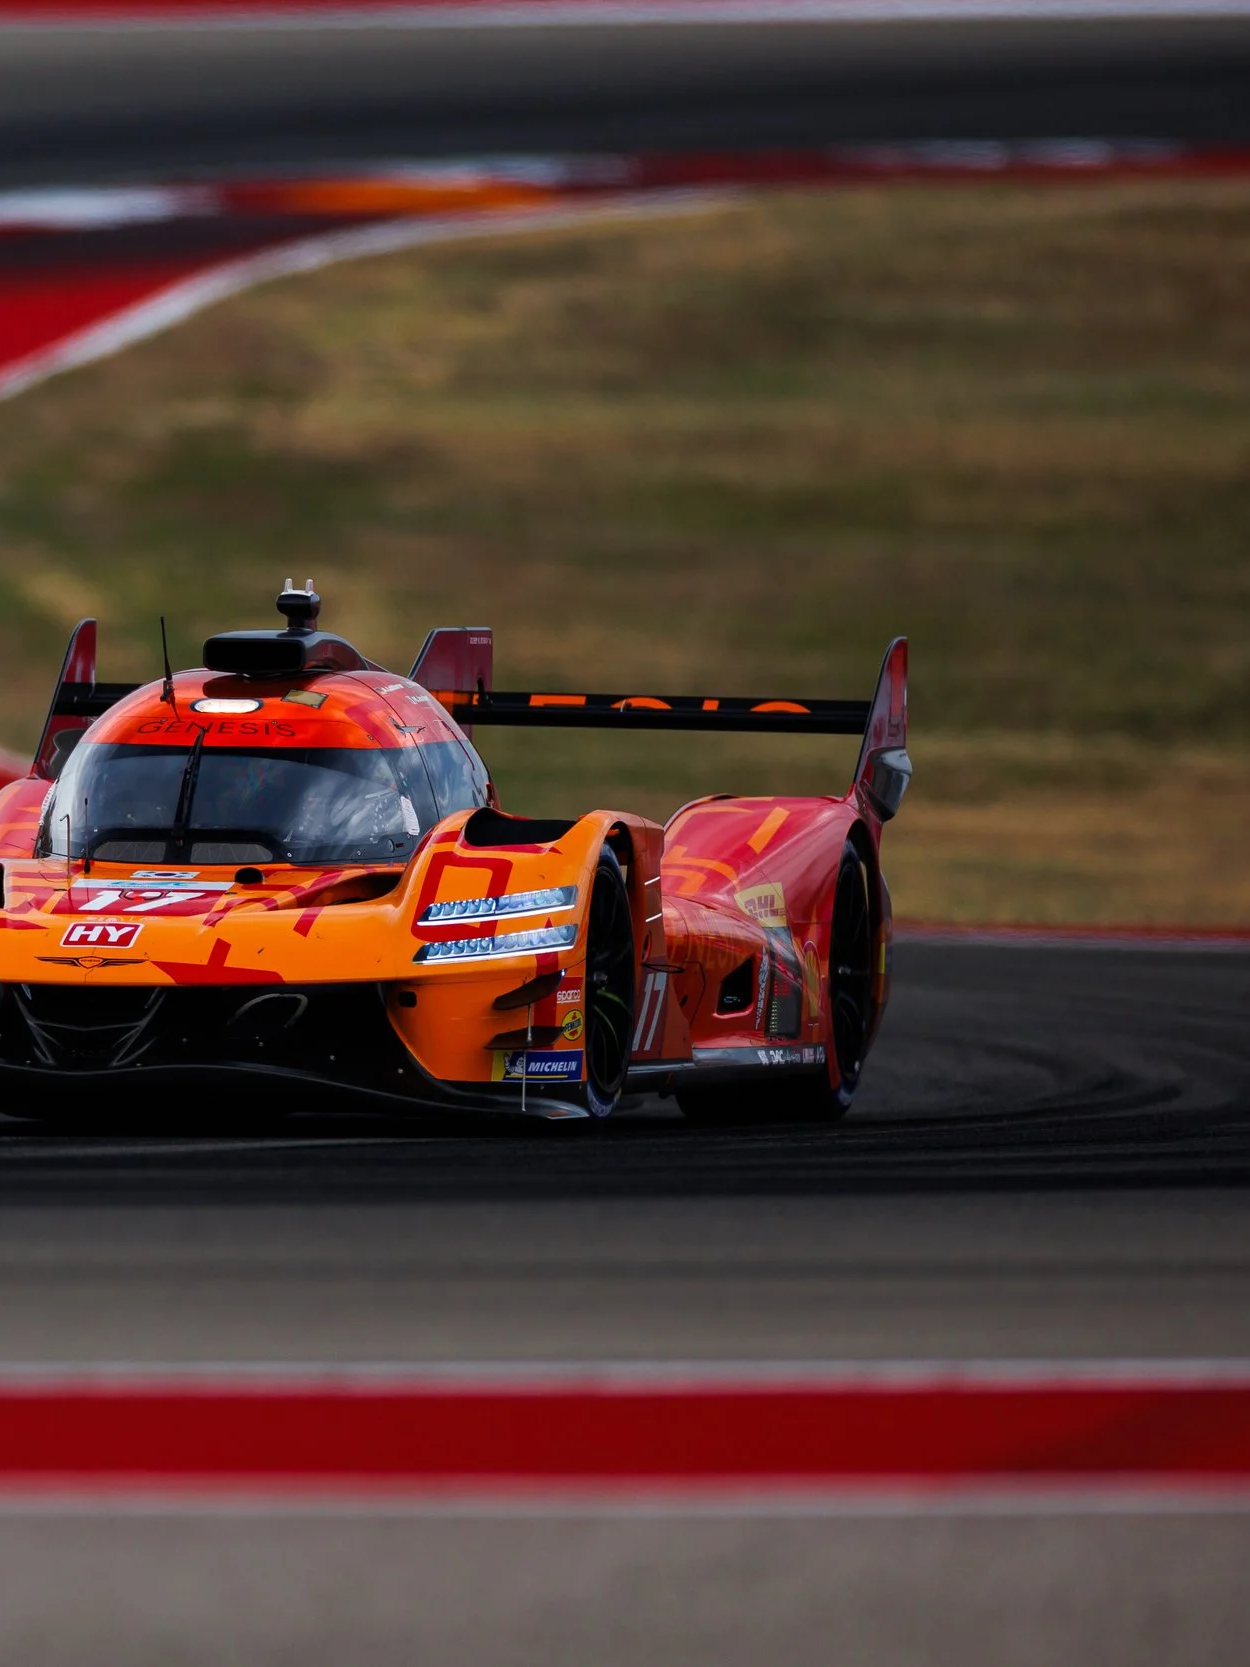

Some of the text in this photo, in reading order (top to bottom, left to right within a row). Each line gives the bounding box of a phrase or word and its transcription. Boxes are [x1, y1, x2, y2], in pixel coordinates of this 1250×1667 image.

[137, 720, 296, 737] GENESIS
[78, 890, 206, 911] 17
[69, 925, 135, 942] HY
[632, 972, 667, 1051] 17
[528, 1061, 577, 1072] MICHELIN
